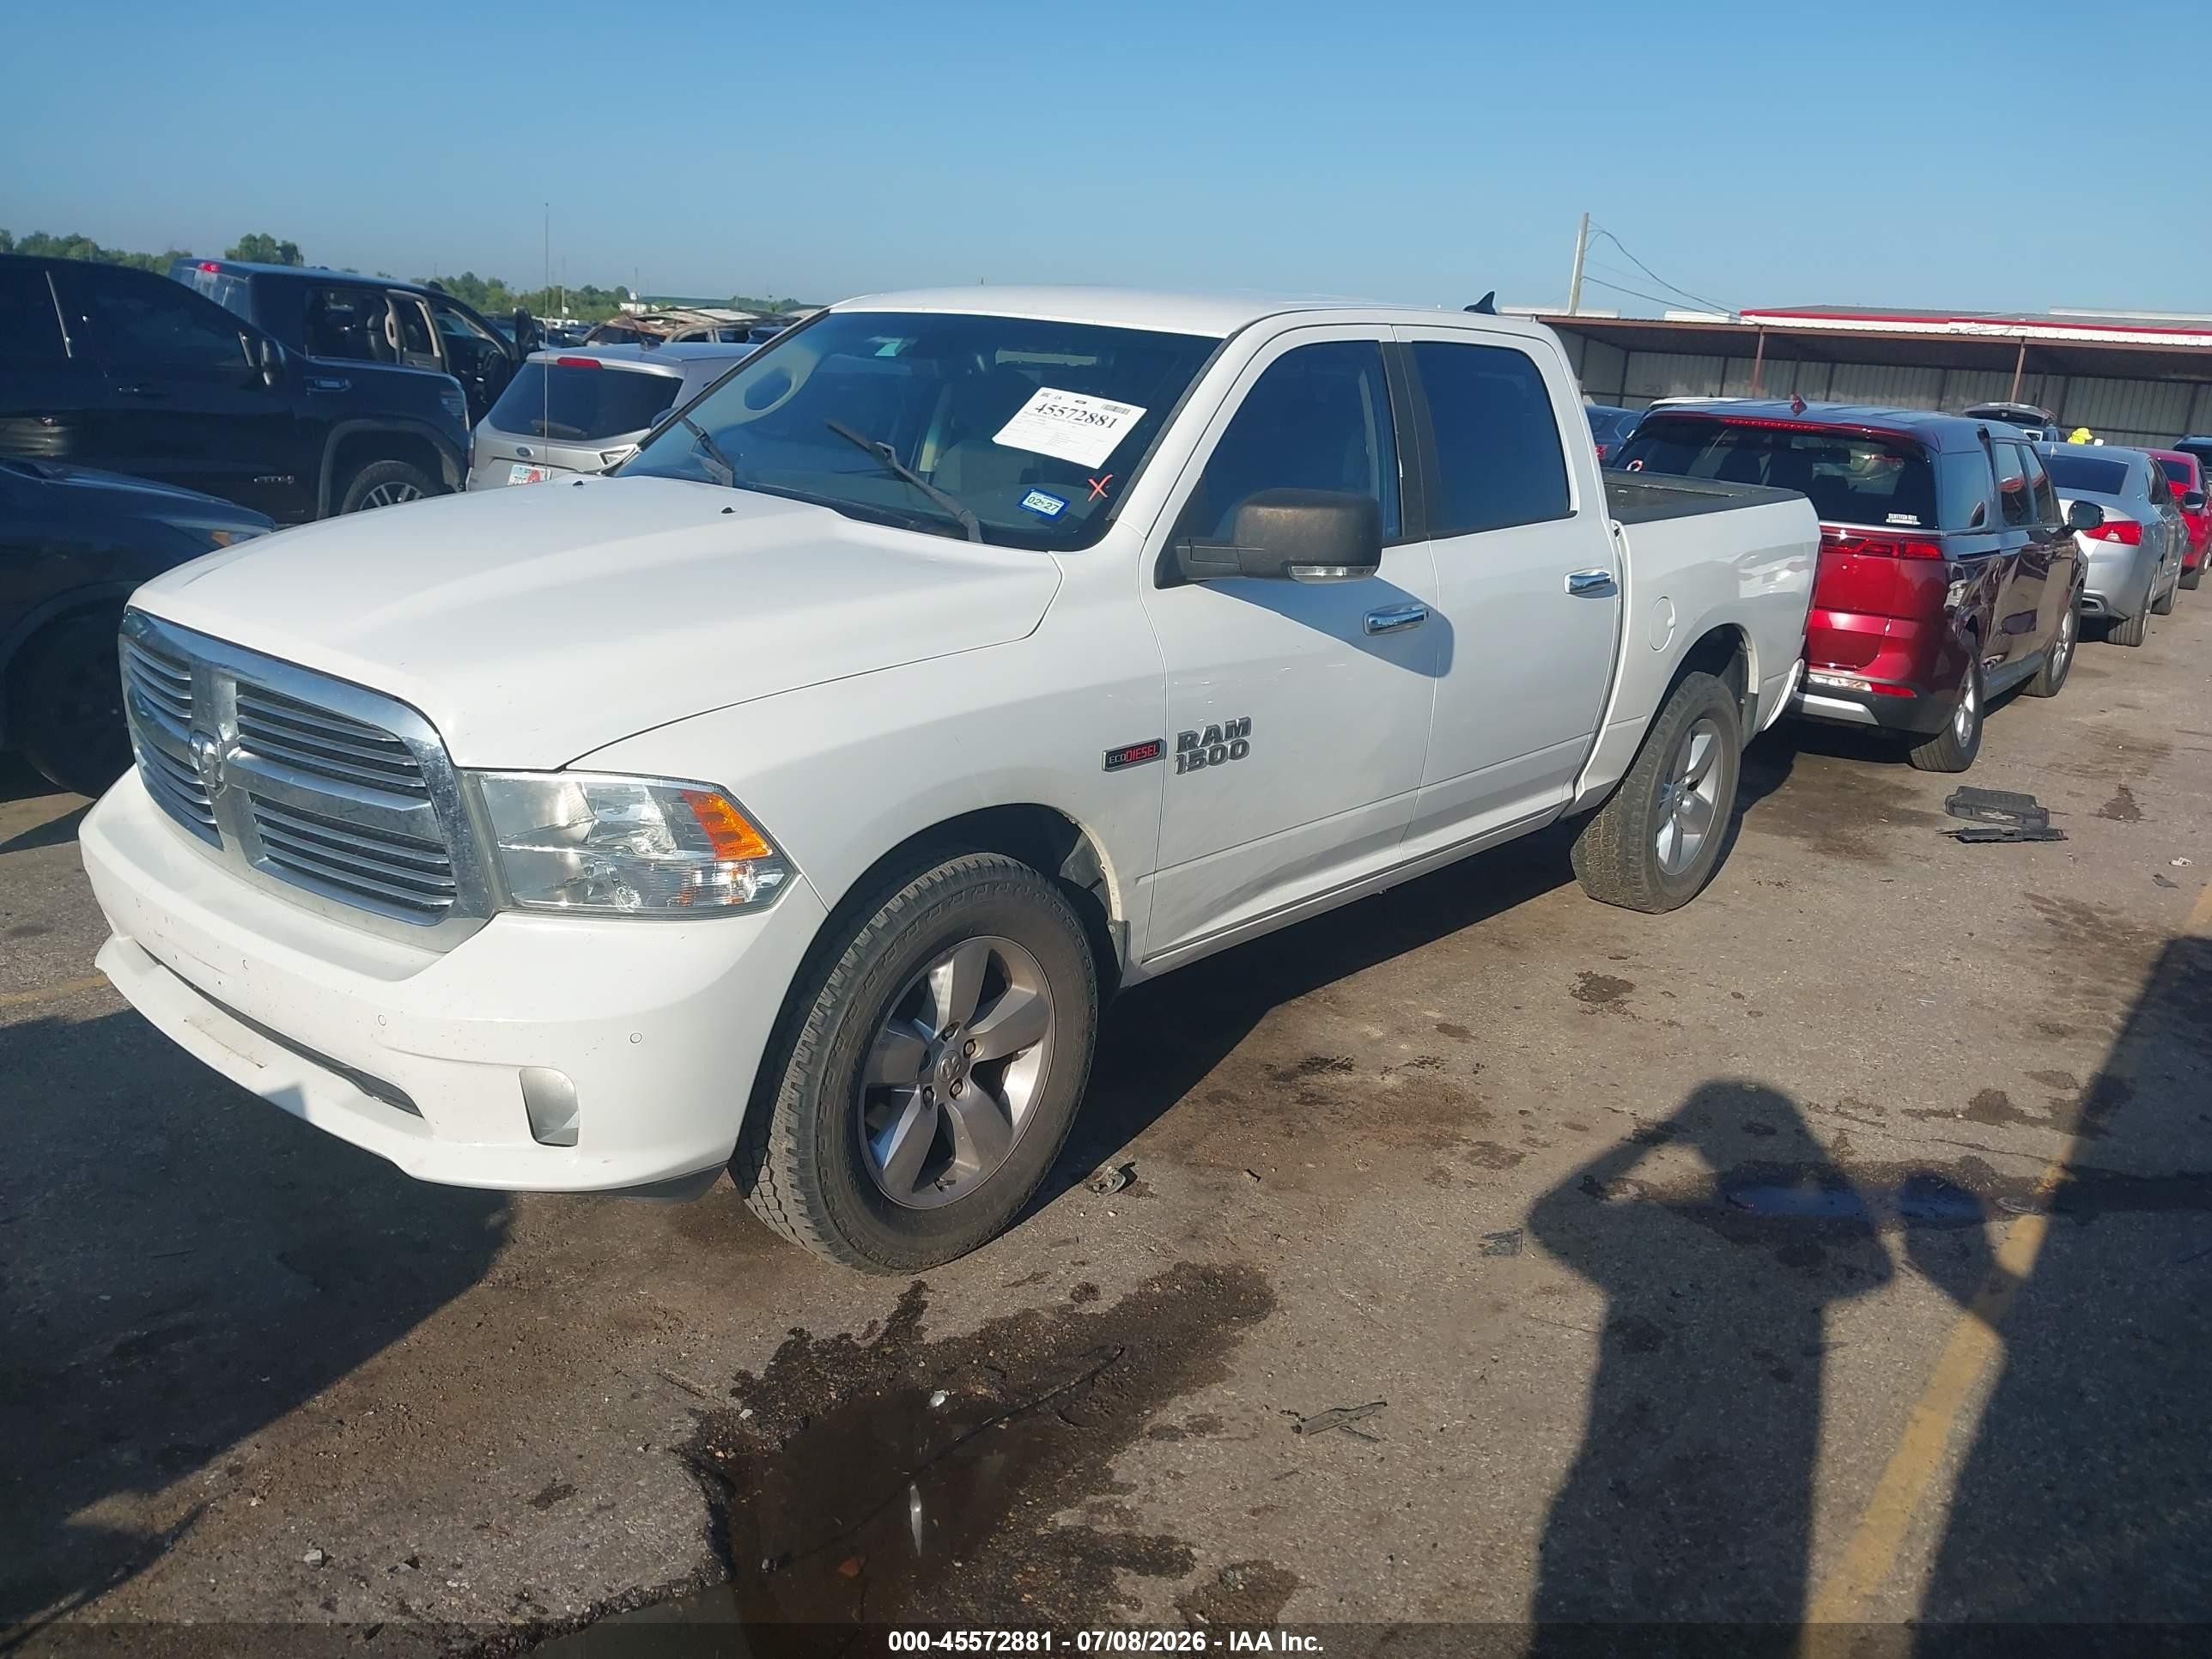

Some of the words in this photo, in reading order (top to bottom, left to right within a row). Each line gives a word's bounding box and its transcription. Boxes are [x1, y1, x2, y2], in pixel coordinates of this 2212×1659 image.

[1035, 403, 1118, 428] 45572881
[1174, 716, 1252, 754] RAM
[1109, 744, 1159, 765] ECODIESEL
[1174, 738, 1250, 775] 1500
